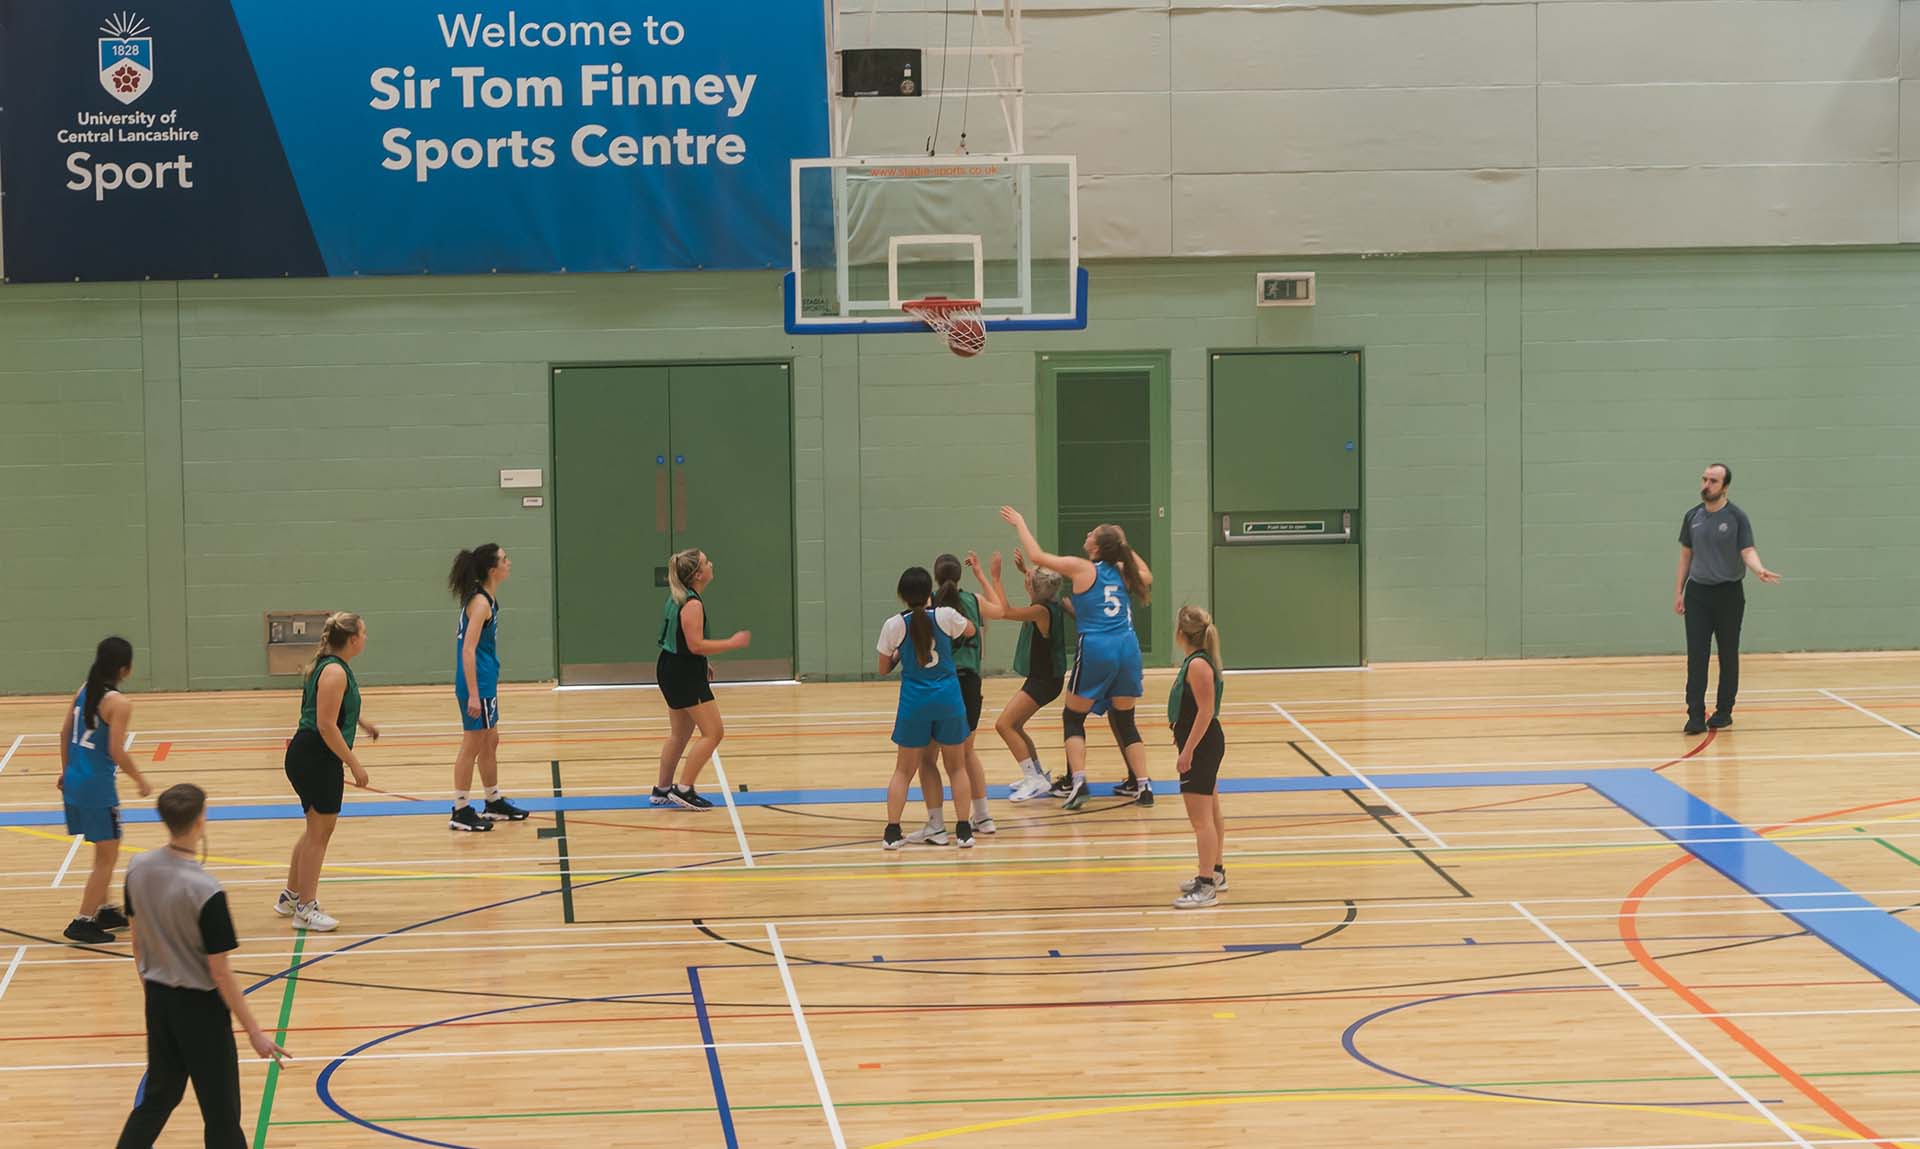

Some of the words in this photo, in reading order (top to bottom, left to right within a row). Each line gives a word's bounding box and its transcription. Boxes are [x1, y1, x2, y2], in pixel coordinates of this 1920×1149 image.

[438, 11, 631, 47] Welcome
[644, 16, 684, 45] to
[112, 44, 139, 56] 1828
[370, 66, 440, 110] Sir
[452, 67, 562, 107] Tom
[582, 63, 756, 117] Finney
[57, 128, 113, 144] Central
[118, 128, 199, 142] Lancashire
[78, 111, 155, 126] University
[160, 110, 176, 123] of
[382, 128, 555, 181] Sports
[572, 125, 745, 166] Centre
[67, 152, 192, 200] Sport
[1104, 586, 1121, 617] 5
[72, 706, 99, 750] 12
